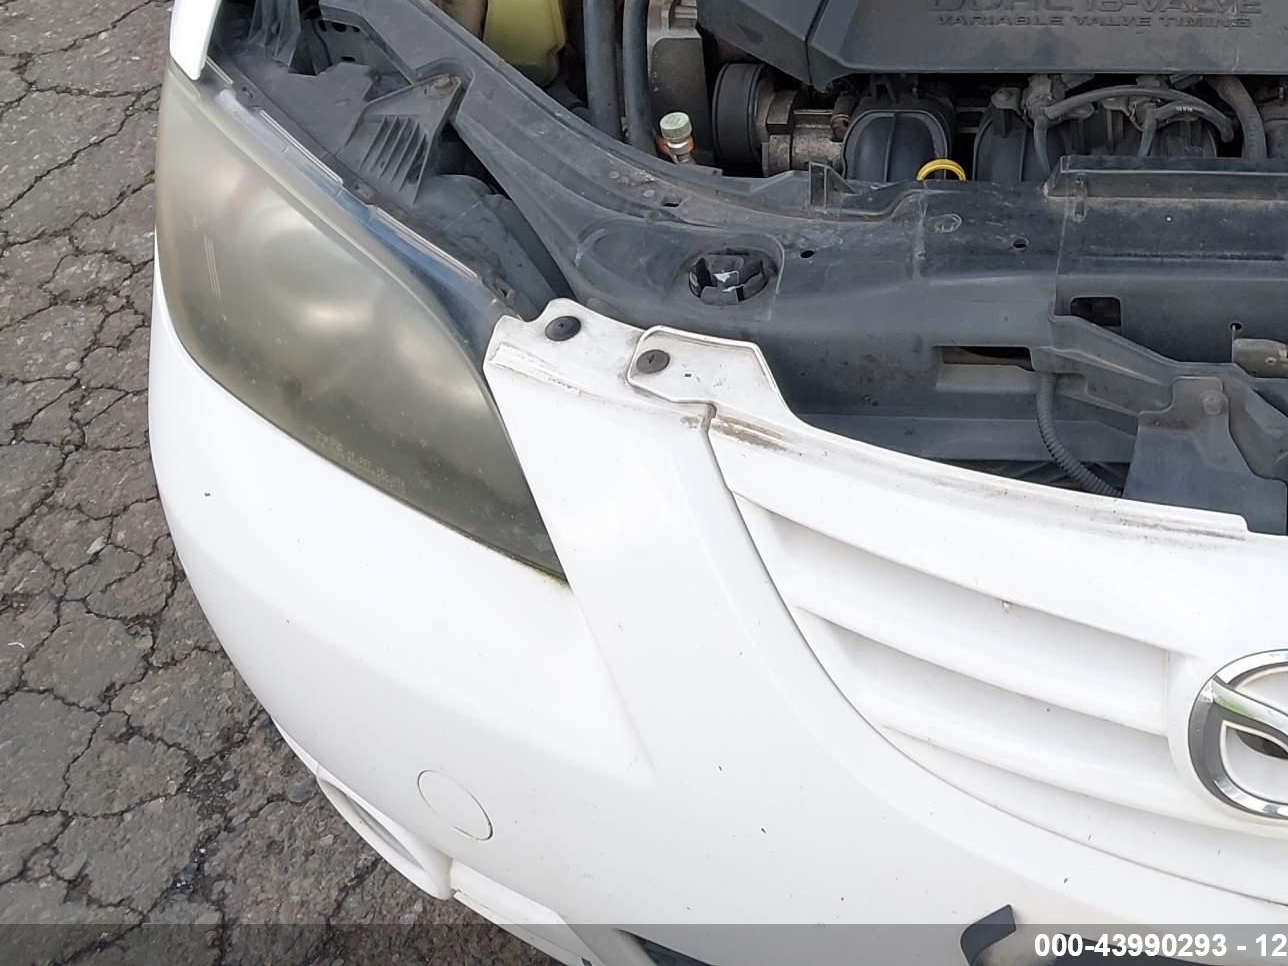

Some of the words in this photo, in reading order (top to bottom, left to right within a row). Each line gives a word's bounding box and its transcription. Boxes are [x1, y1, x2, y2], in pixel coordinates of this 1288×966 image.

[937, 15, 1065, 27] VARIABLE
[1071, 15, 1152, 27] VALVE
[1158, 16, 1253, 28] TIMING
